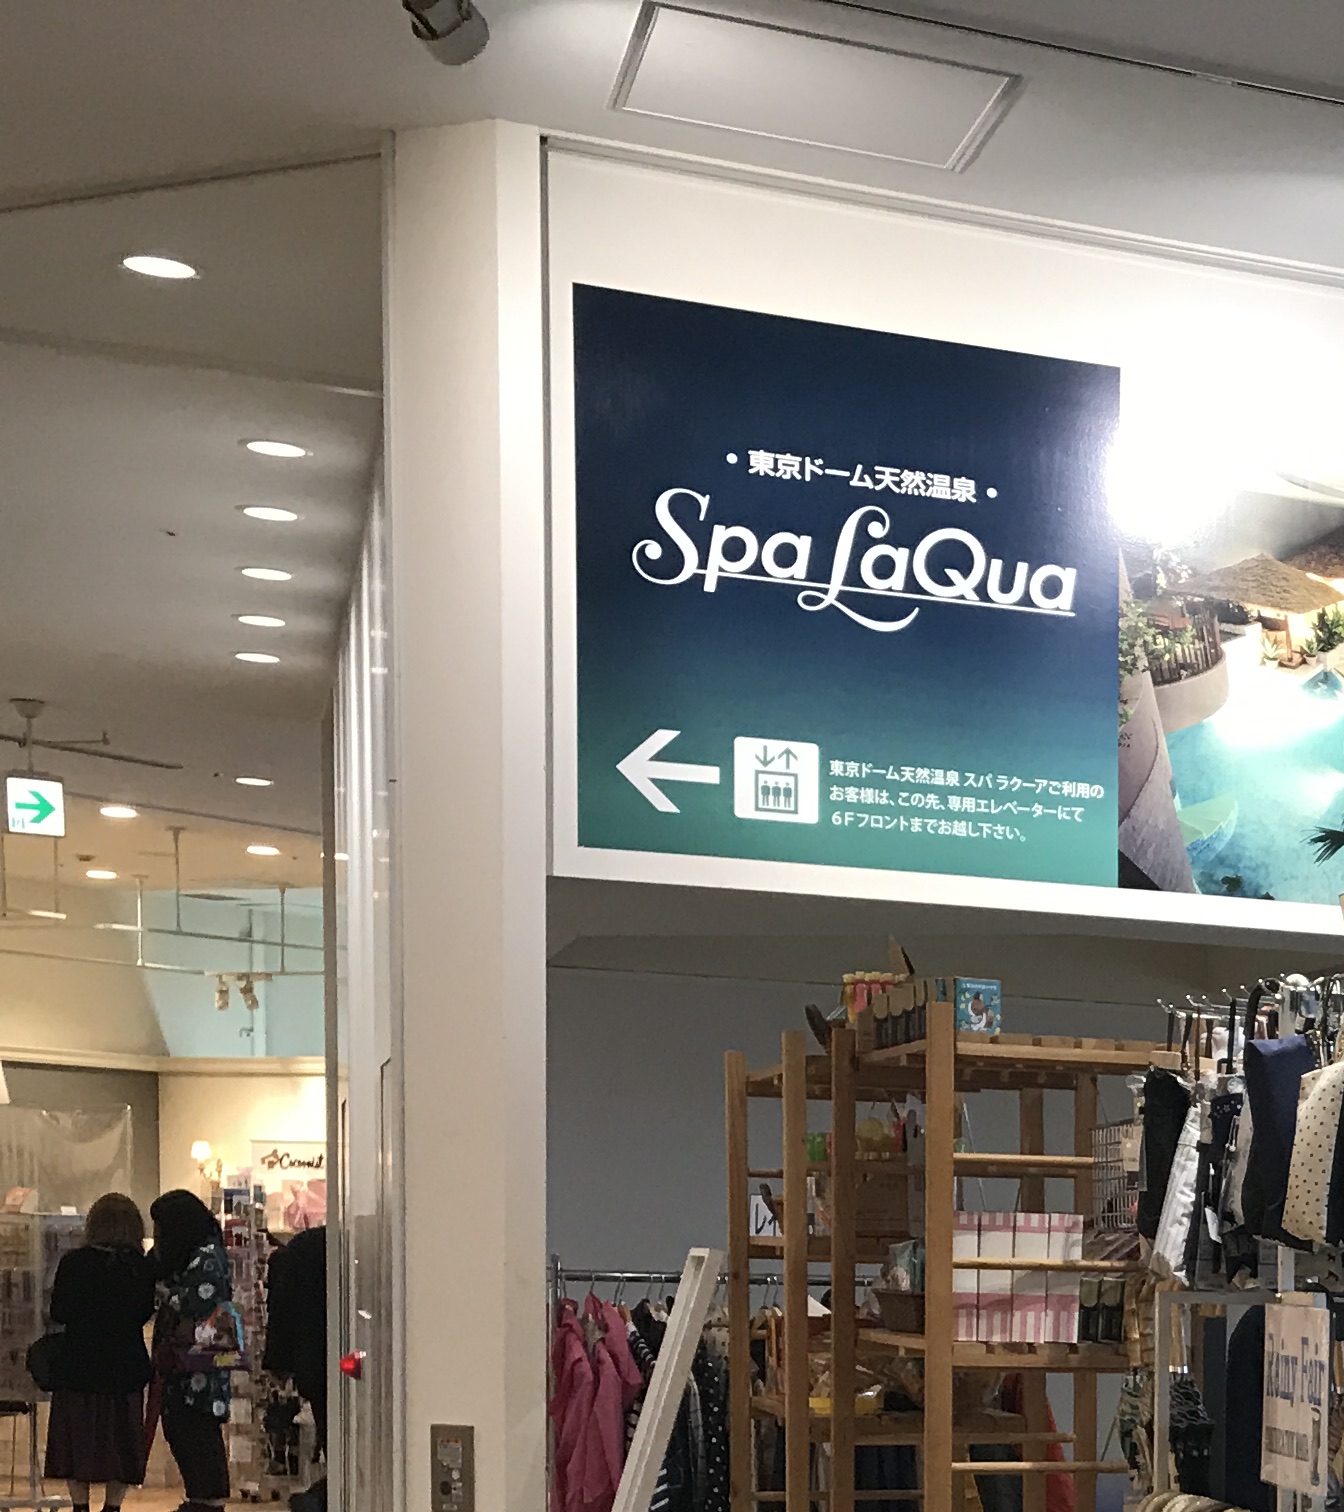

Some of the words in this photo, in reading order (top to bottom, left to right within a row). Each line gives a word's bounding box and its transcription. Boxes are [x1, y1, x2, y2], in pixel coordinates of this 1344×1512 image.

[747, 449, 977, 503] 東京ドーム天然温泉
[632, 488, 811, 593] Spa
[798, 505, 1076, 632] LaQua
[829, 760, 960, 786] 東京ドーム天然温泉
[829, 785, 1085, 822] お客様は、この先、専用エレベーターにて
